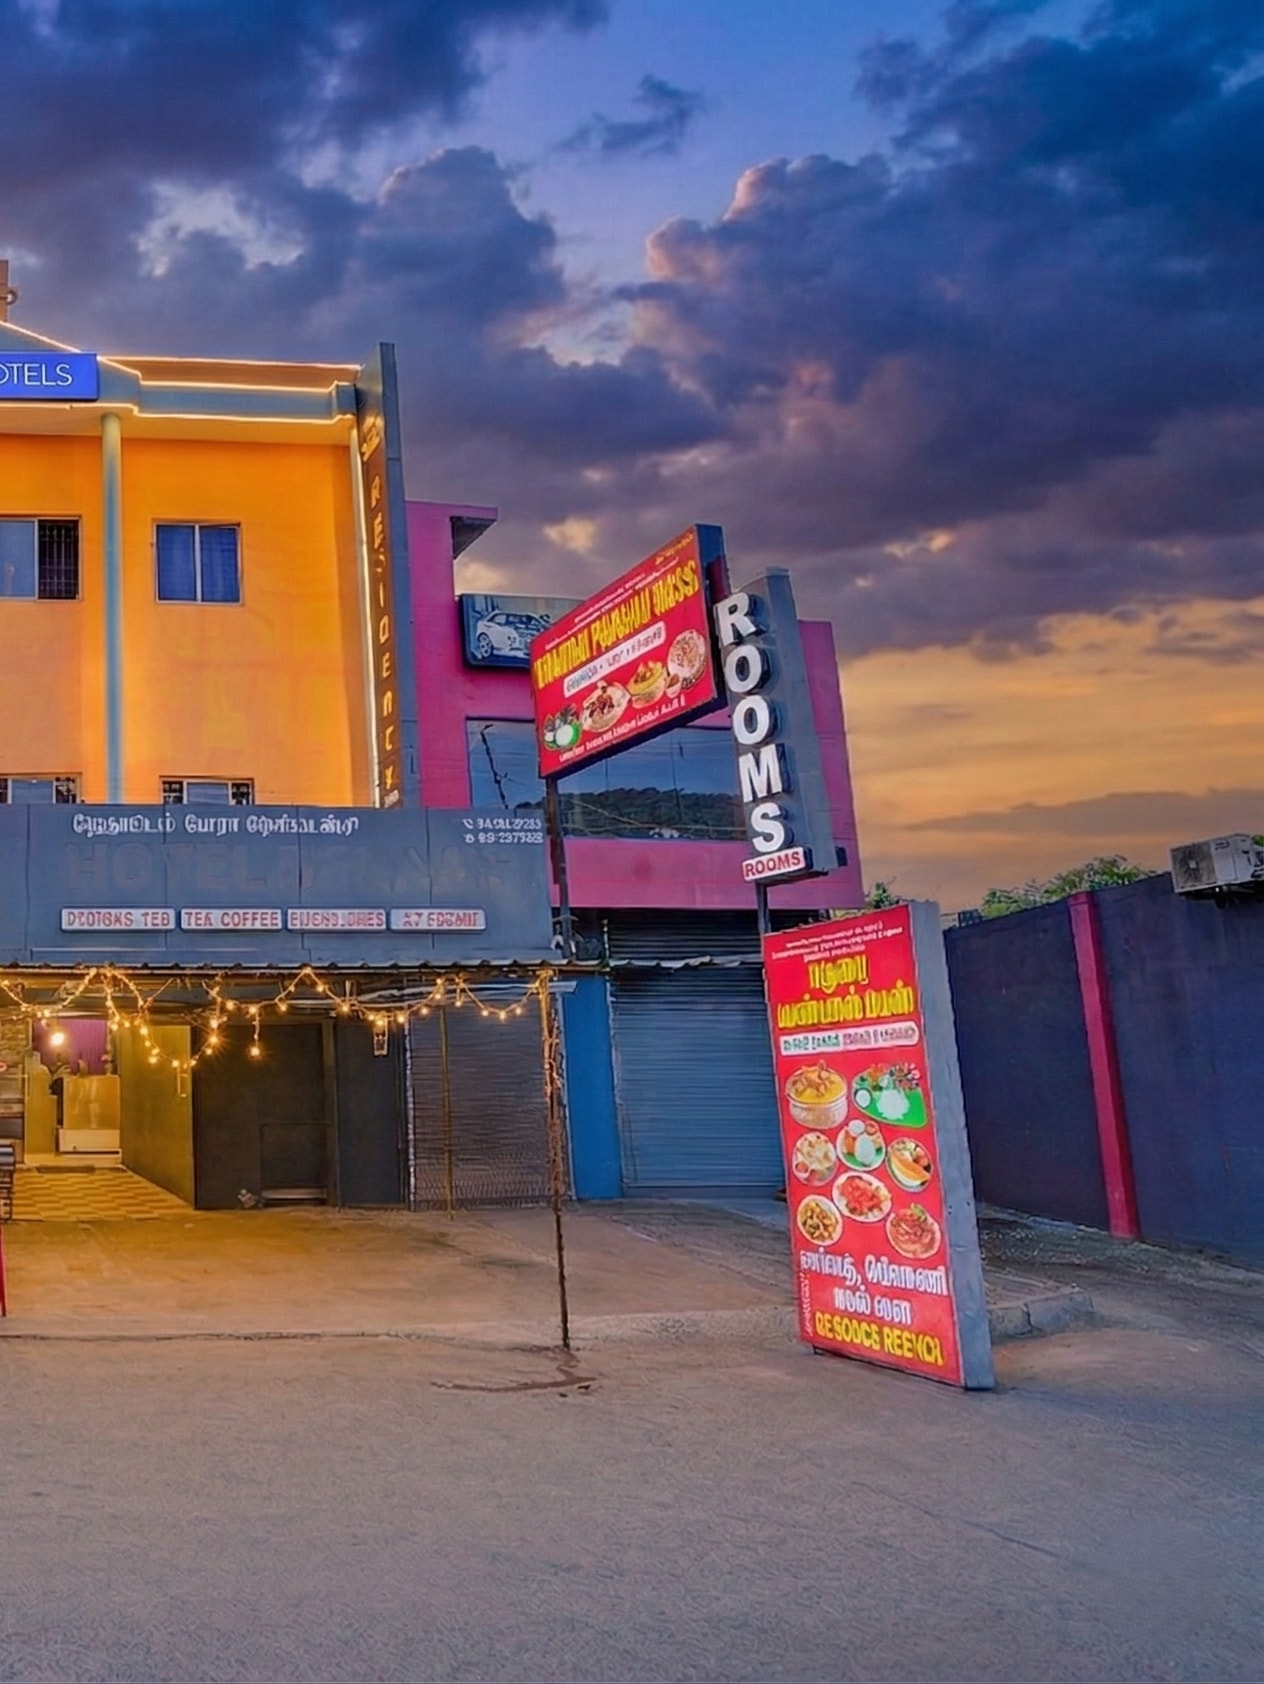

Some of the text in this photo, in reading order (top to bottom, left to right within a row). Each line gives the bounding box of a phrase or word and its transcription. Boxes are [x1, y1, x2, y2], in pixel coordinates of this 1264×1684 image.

[715, 591, 785, 852] ROOMS
[744, 851, 802, 878] ROOMS
[184, 911, 212, 927] TEA
[220, 911, 279, 927] COFFEE
